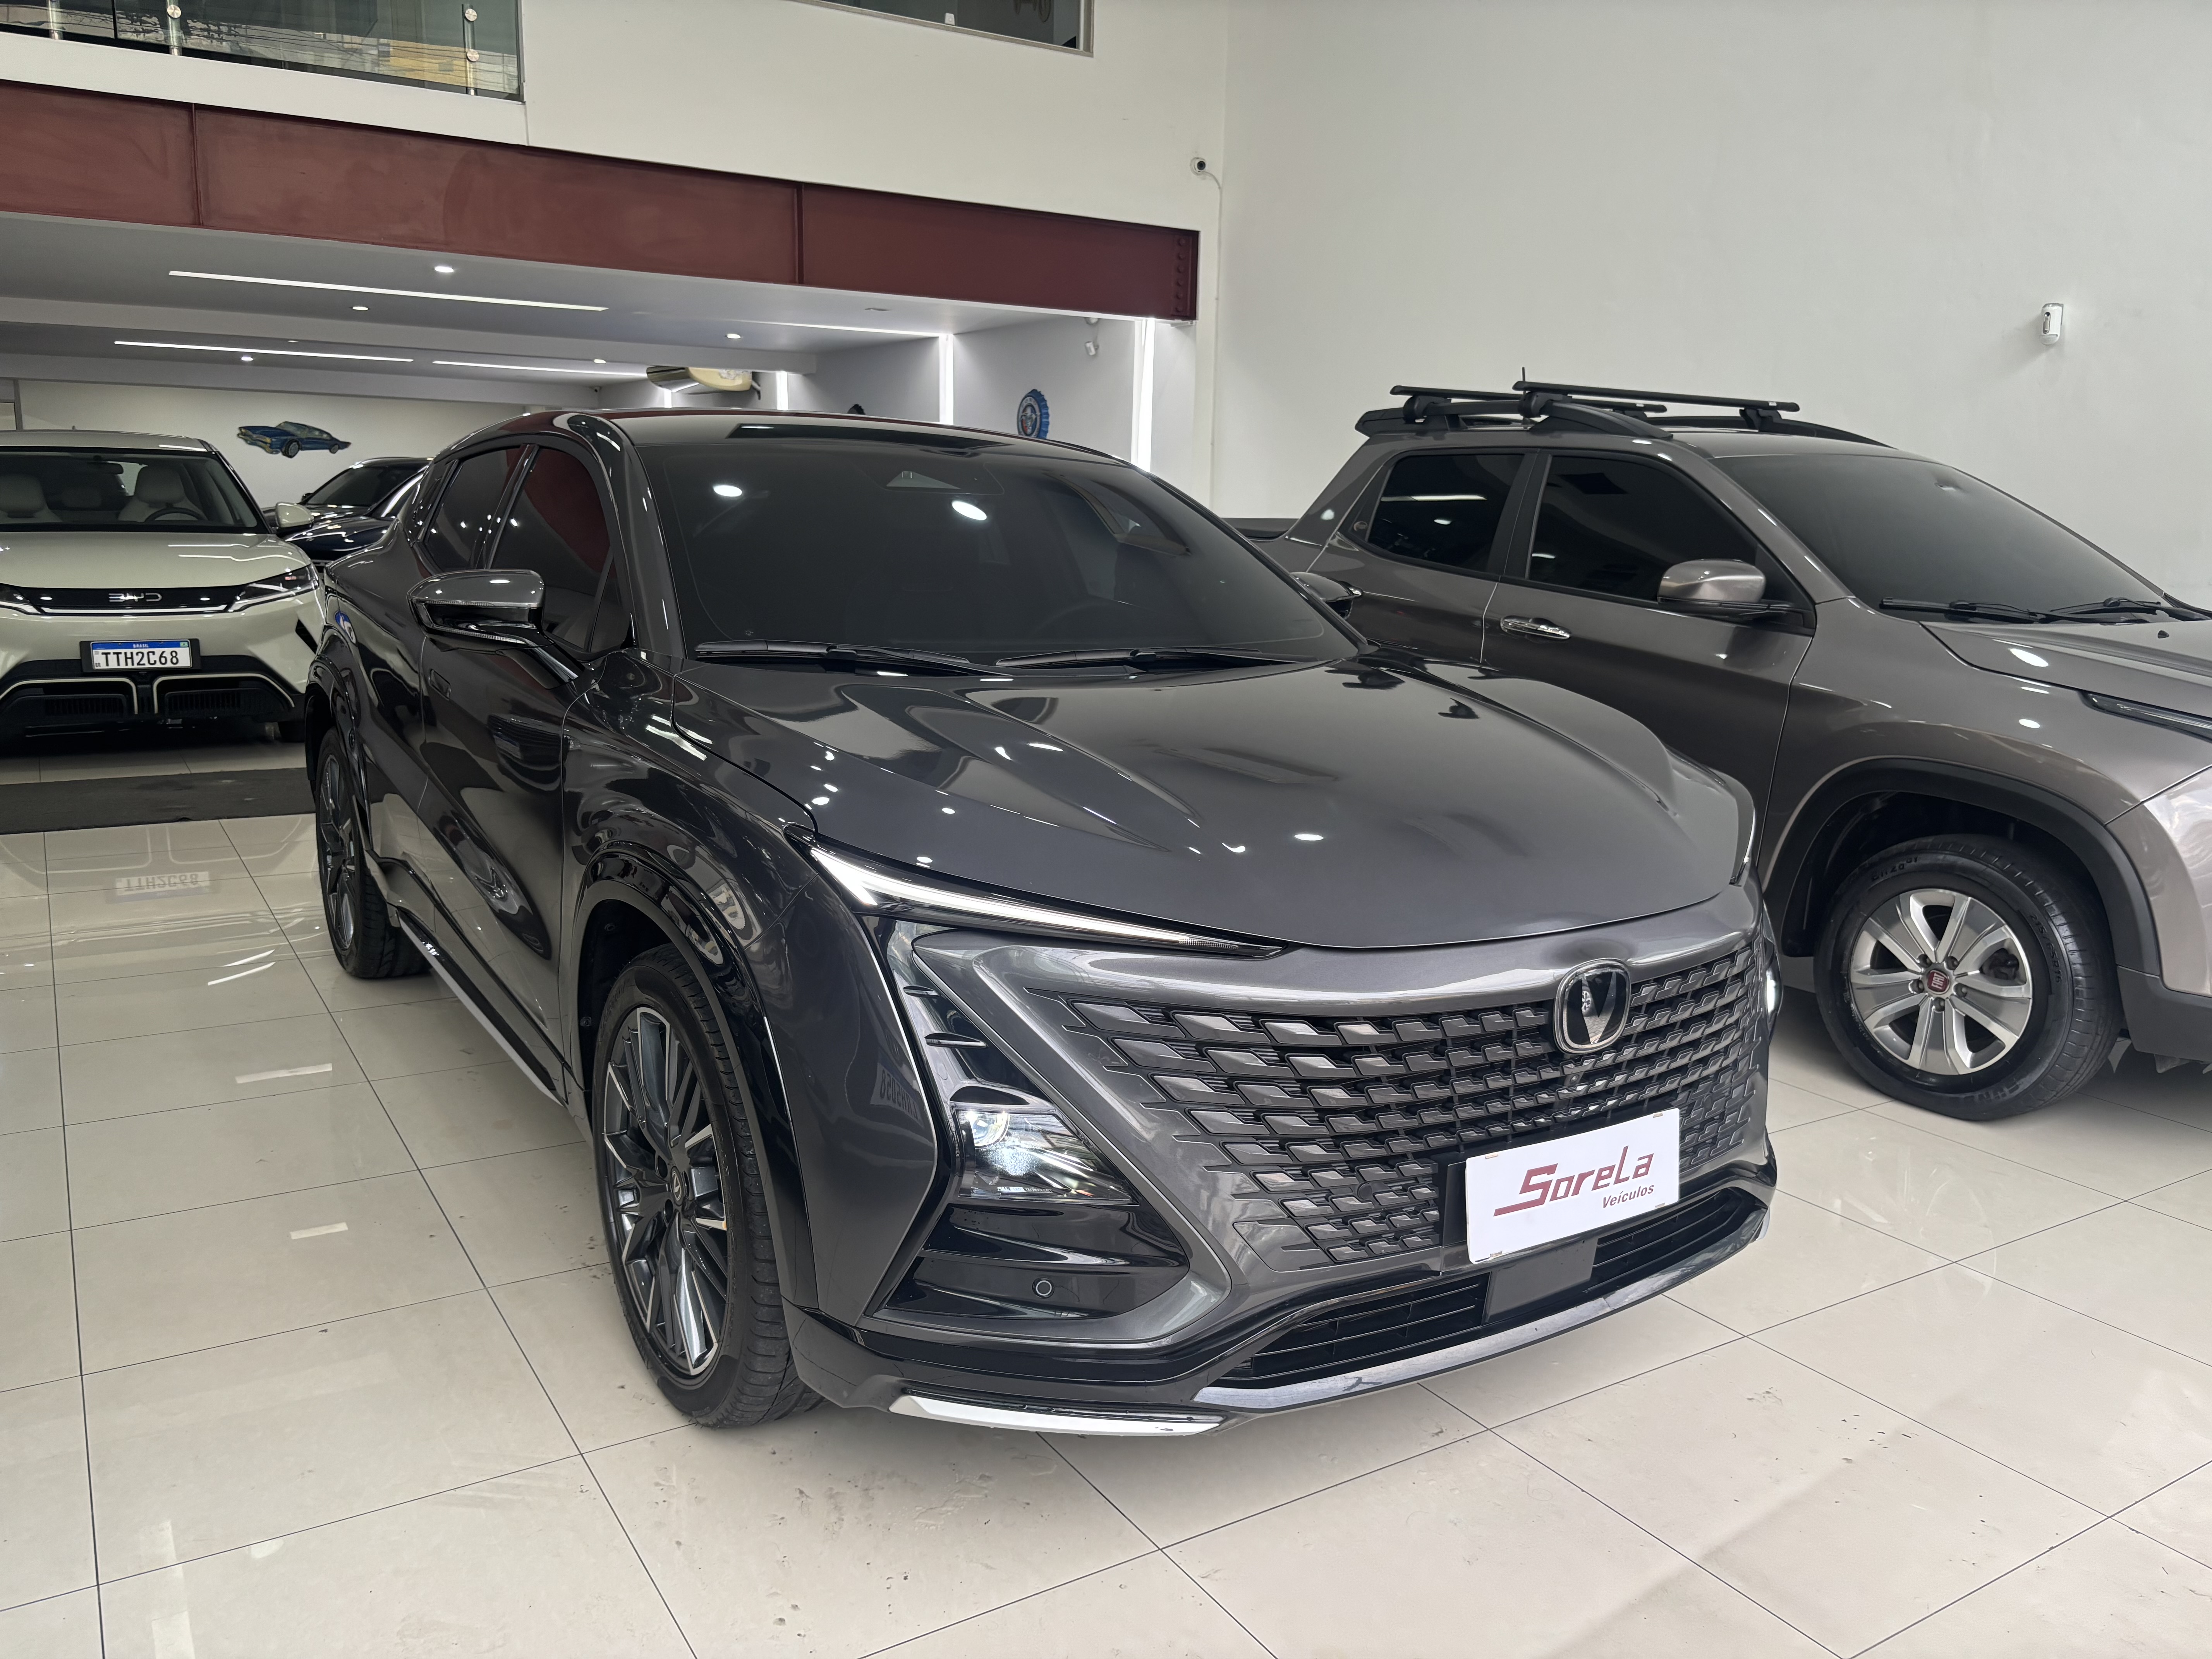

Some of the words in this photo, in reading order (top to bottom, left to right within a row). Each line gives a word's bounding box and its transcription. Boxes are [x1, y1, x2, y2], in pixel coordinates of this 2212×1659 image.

[108, 593, 162, 602] BYD
[101, 650, 179, 667] TTH2C68
[1931, 972, 1945, 990] FIAT
[1602, 1183, 1654, 1208] Veículos
